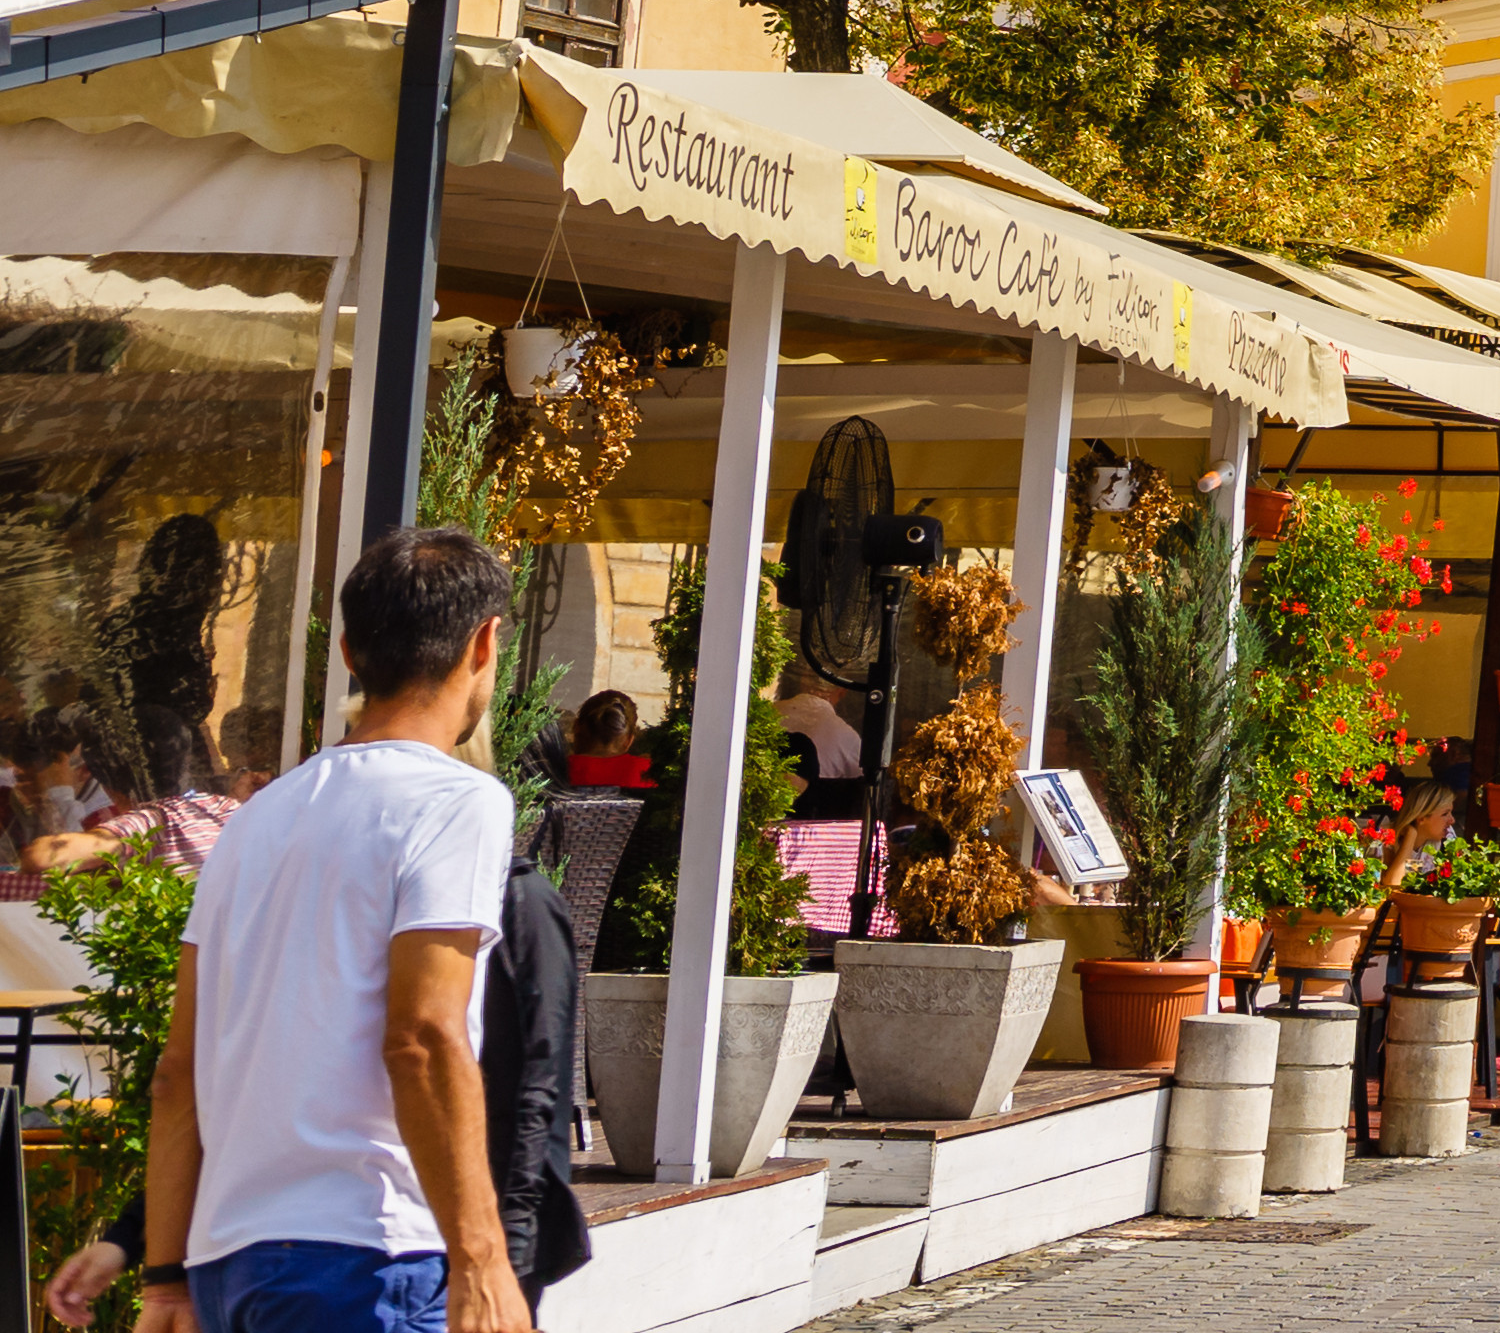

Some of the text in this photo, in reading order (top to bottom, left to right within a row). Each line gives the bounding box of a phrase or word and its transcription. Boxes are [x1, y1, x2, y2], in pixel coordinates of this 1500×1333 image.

[607, 81, 795, 221] Restaurant
[894, 177, 991, 282] Baroc
[997, 220, 1066, 312] Café
[1074, 257, 1095, 322] by
[1228, 309, 1288, 398] Pizzerie
